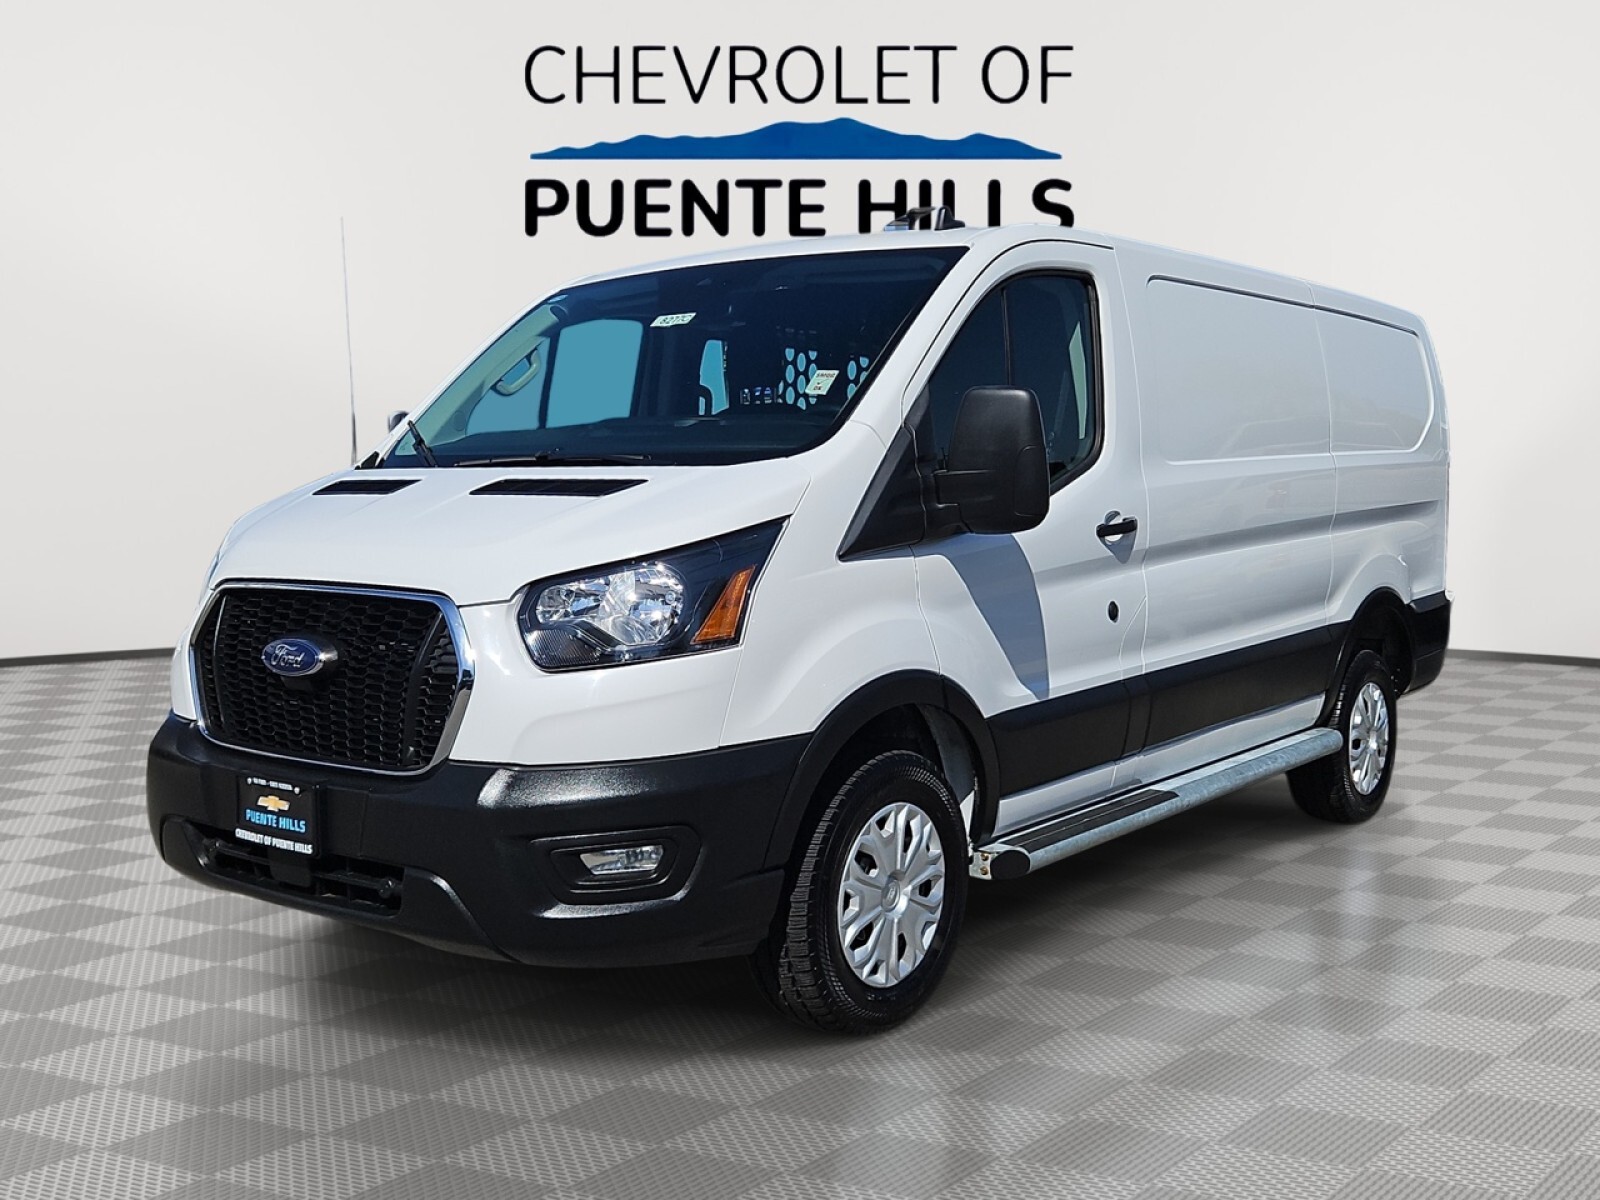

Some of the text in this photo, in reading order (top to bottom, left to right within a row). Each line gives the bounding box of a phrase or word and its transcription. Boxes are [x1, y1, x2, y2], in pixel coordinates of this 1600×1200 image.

[524, 45, 1074, 104] CHEVROLET OF
[524, 179, 826, 237] PUENTE
[270, 643, 306, 668] Ford
[245, 809, 306, 833] PUENTE HILLS
[294, 841, 313, 855] HILLS
